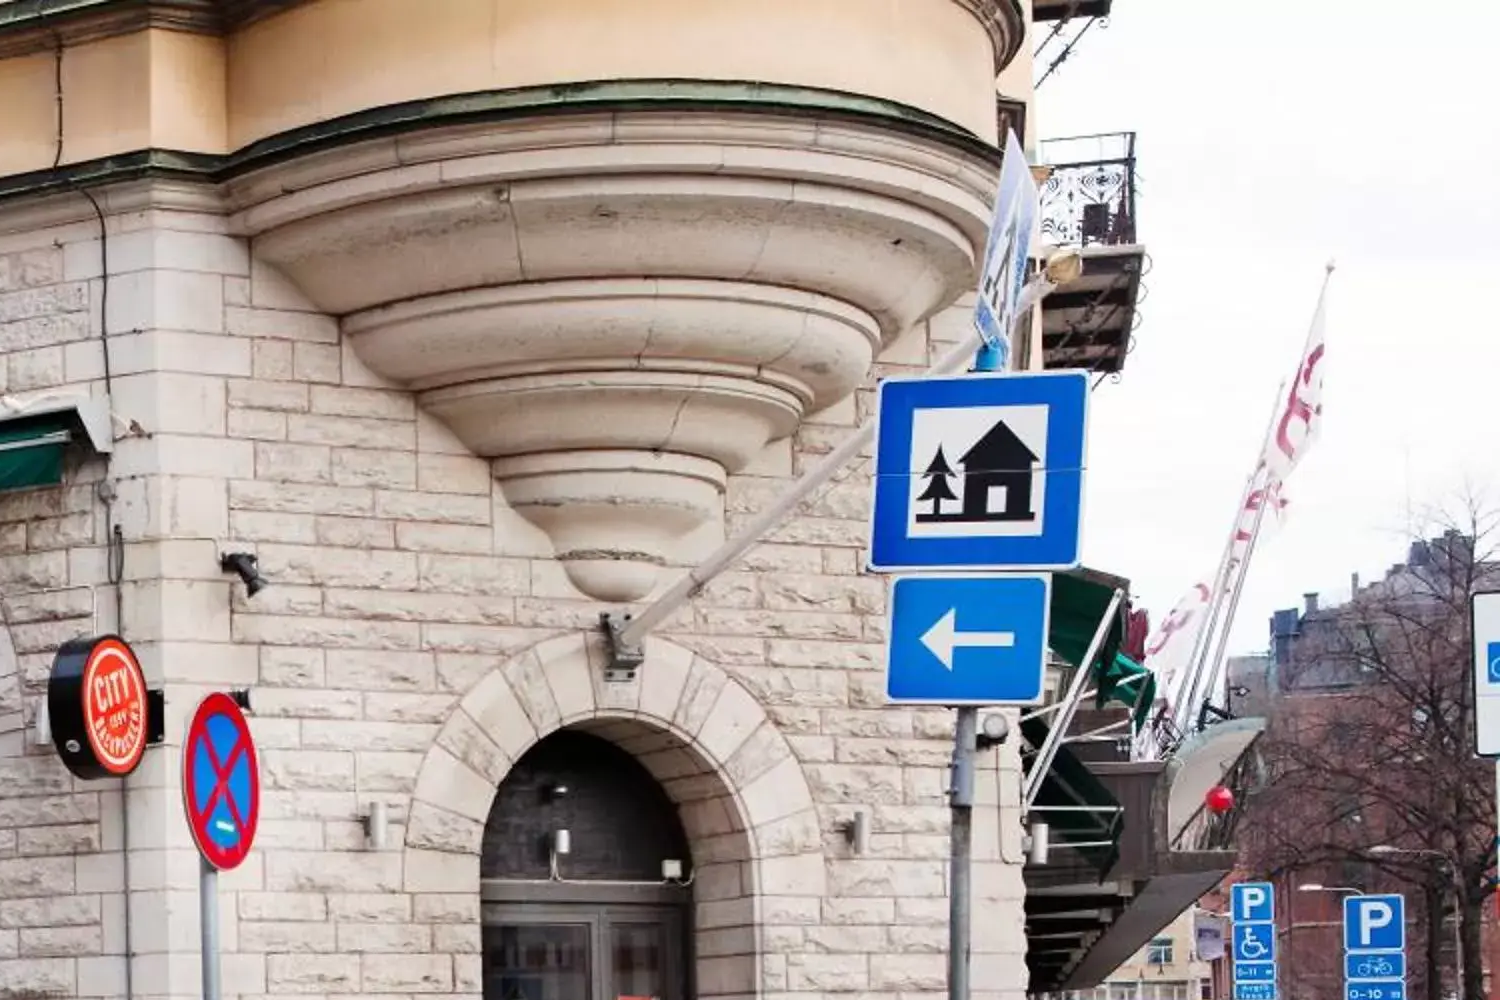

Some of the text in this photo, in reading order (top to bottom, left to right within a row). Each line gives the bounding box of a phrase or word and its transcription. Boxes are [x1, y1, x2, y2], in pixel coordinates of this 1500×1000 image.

[94, 667, 130, 713] CITY
[1242, 887, 1265, 919] P
[1360, 901, 1393, 945] P
